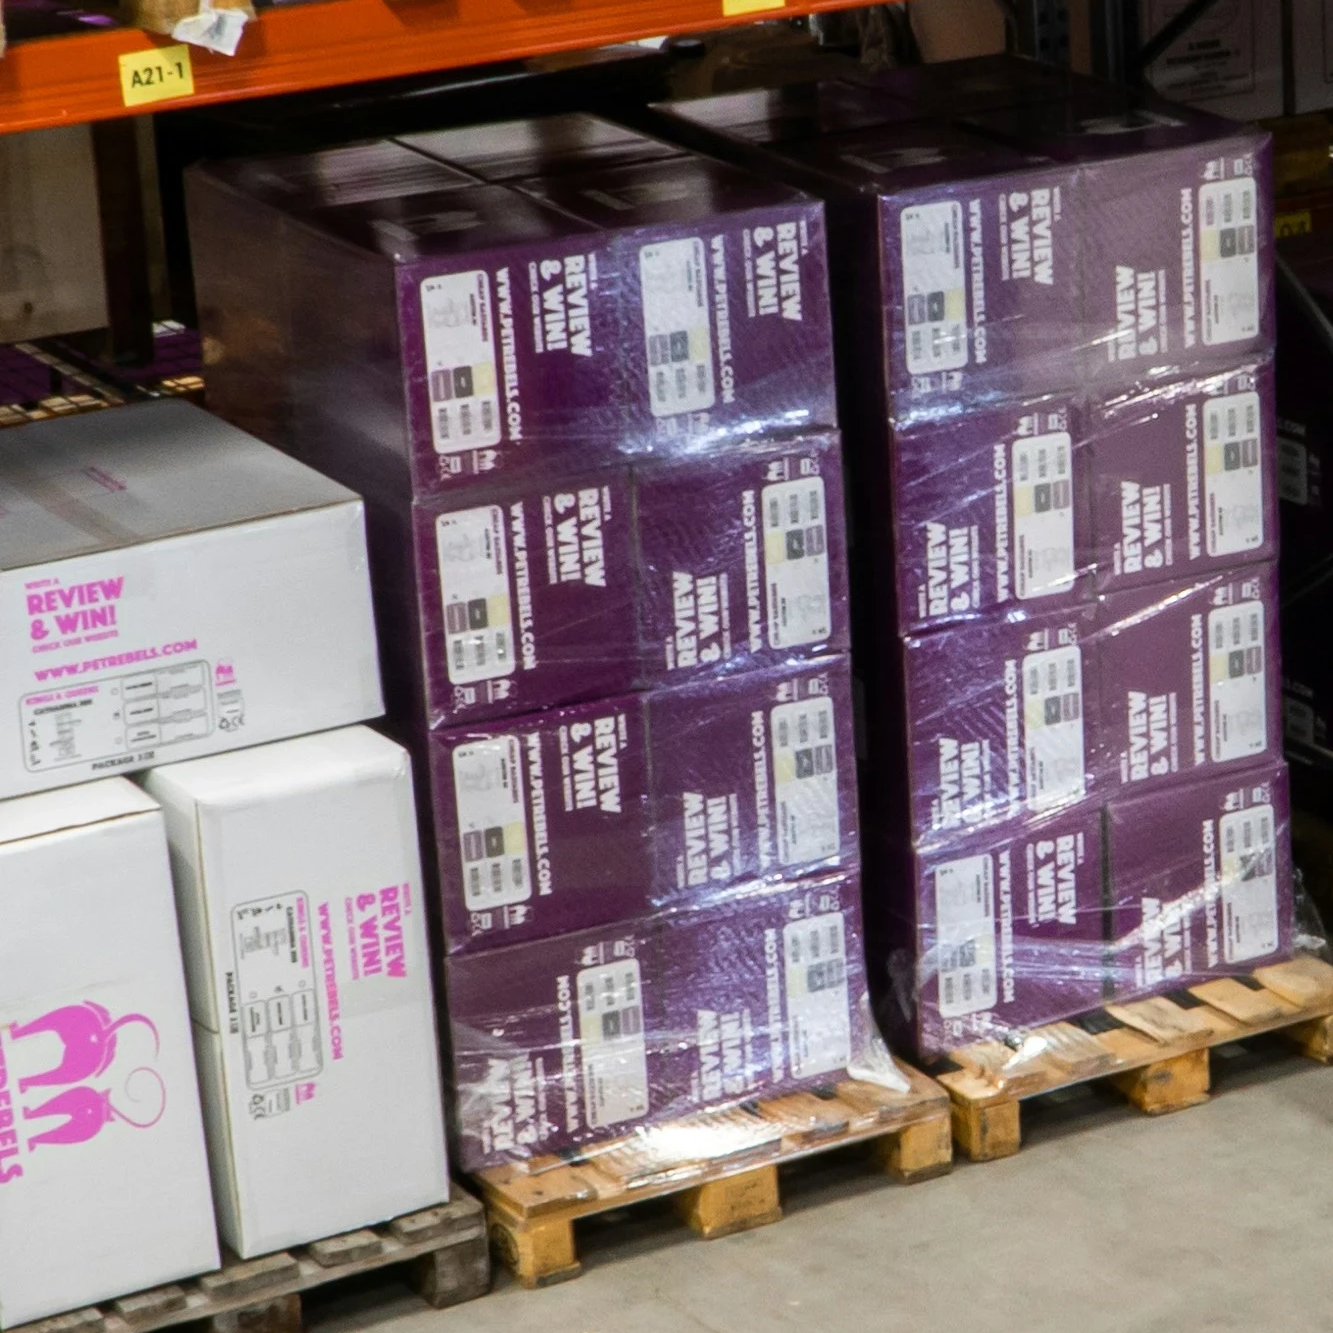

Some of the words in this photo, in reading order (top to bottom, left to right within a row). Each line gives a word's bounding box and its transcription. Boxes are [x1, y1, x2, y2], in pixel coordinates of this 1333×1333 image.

[131, 60, 185, 88] A21-1
[1009, 191, 1029, 212] &
[753, 227, 775, 247] &
[1010, 215, 1032, 279] WIN!
[1030, 188, 1054, 285] REVIEW
[540, 260, 562, 280] &
[755, 251, 779, 316] WIN!
[775, 221, 802, 321] REVIEW
[542, 286, 568, 351] WIN!
[564, 253, 594, 357] REVIEW
[1114, 265, 1137, 363] REVIEW
[1137, 272, 1157, 333] WIN!
[554, 493, 575, 513] &
[1121, 481, 1142, 574] REVIEW
[1142, 485, 1163, 545] WIN!
[556, 517, 582, 582] WIN!
[578, 486, 608, 587] REVIEW
[26, 576, 124, 617] REVIEW
[925, 521, 949, 616] REVIEW
[30, 618, 49, 640] &
[55, 605, 116, 636] WIN!
[672, 571, 699, 668] REVIEW
[696, 575, 719, 638] WIN!
[34, 638, 198, 682] WWW.PETREBELS.COM
[570, 722, 592, 743] &
[1128, 691, 1149, 781] REVIEW
[1148, 694, 1168, 754] WIN!
[571, 746, 597, 809] WIN!
[594, 714, 622, 813] REVIEW
[356, 893, 377, 912] &
[1035, 862, 1058, 923] WIN!
[1055, 834, 1078, 925] REVIEW
[358, 916, 382, 976] WIN!
[380, 884, 408, 978] REVIEW
